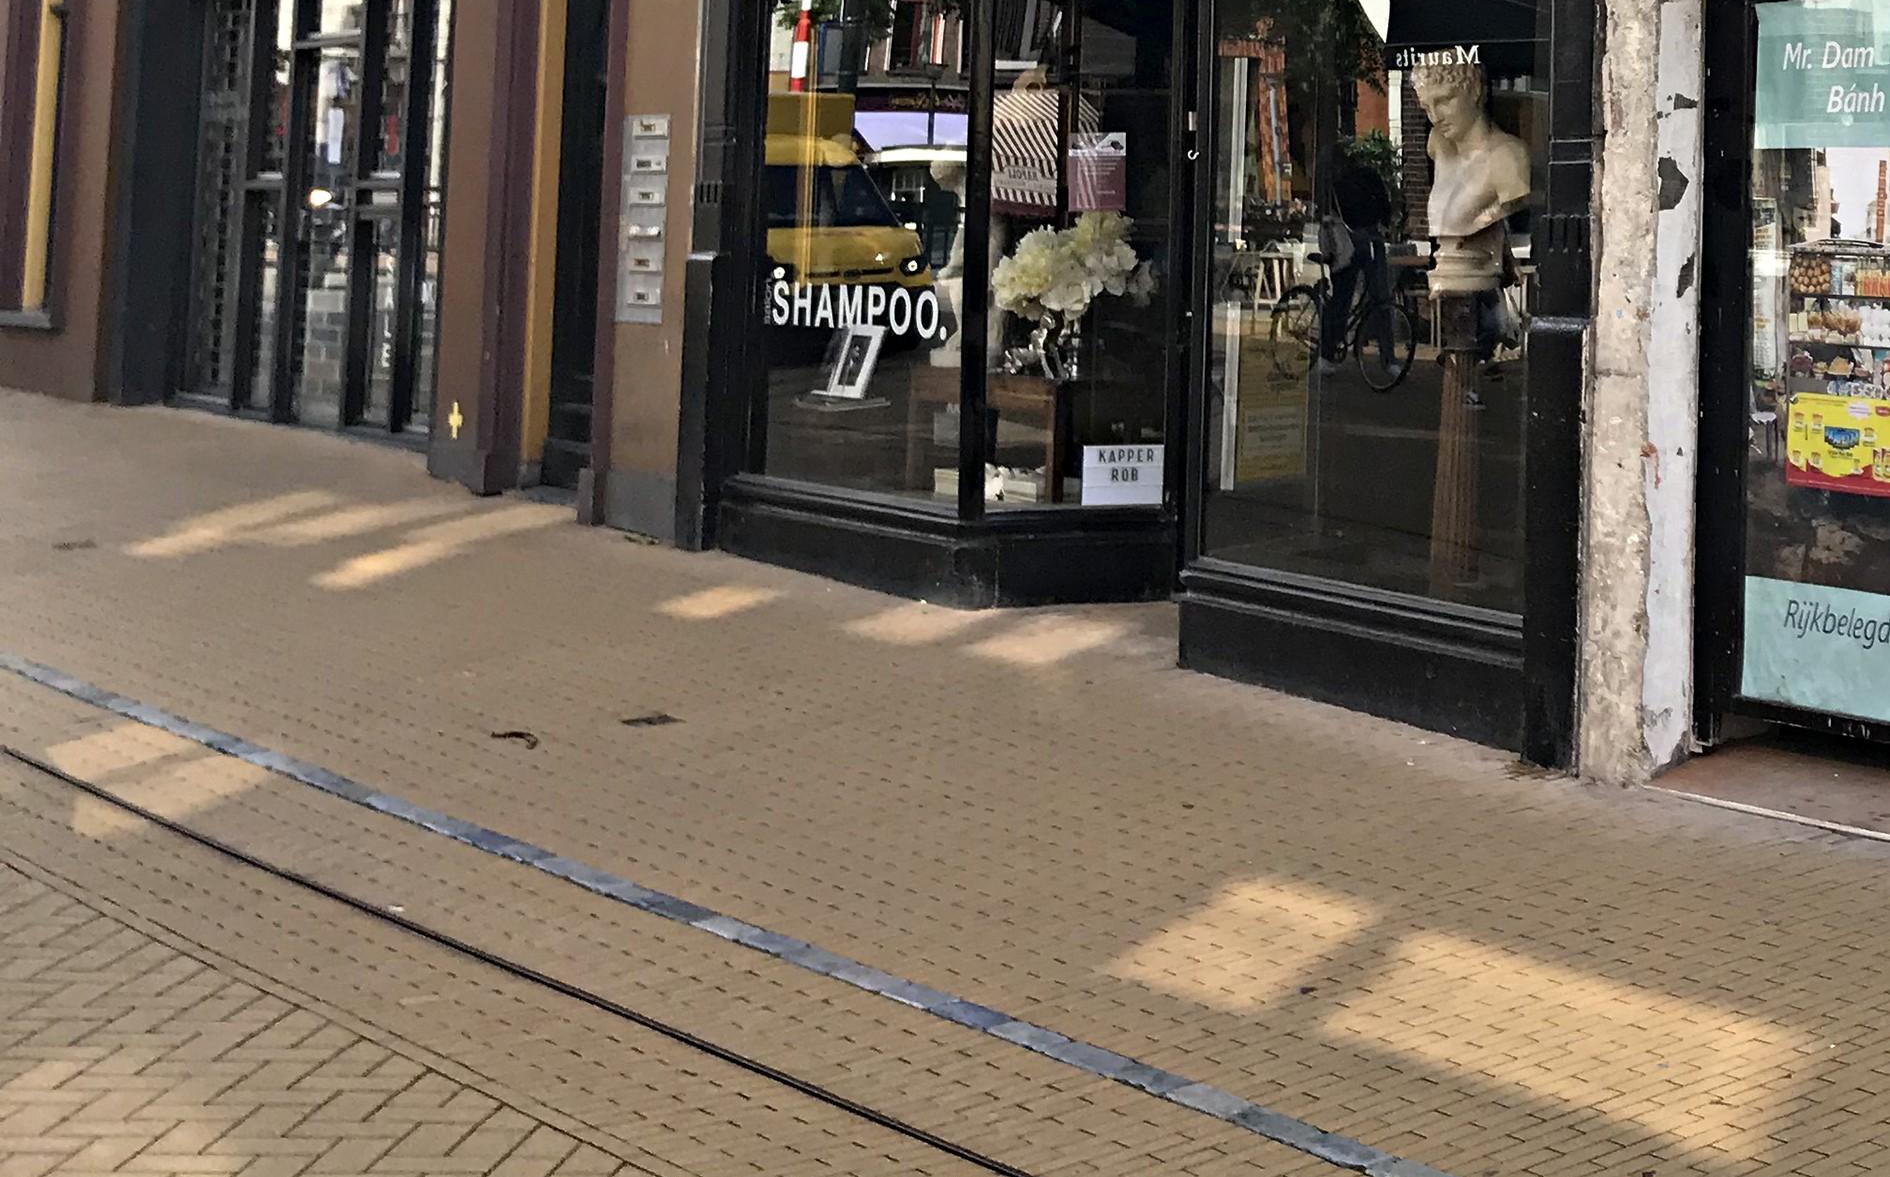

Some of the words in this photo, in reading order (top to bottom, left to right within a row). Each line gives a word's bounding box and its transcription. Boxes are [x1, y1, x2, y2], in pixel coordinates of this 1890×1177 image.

[1782, 42, 1813, 71] Mr.
[1821, 40, 1875, 70] Dam
[1826, 81, 1885, 114] Bánh
[771, 279, 948, 341] SHAMPOO.
[1098, 448, 1154, 463] KAPPER
[1111, 467, 1139, 482] ROB
